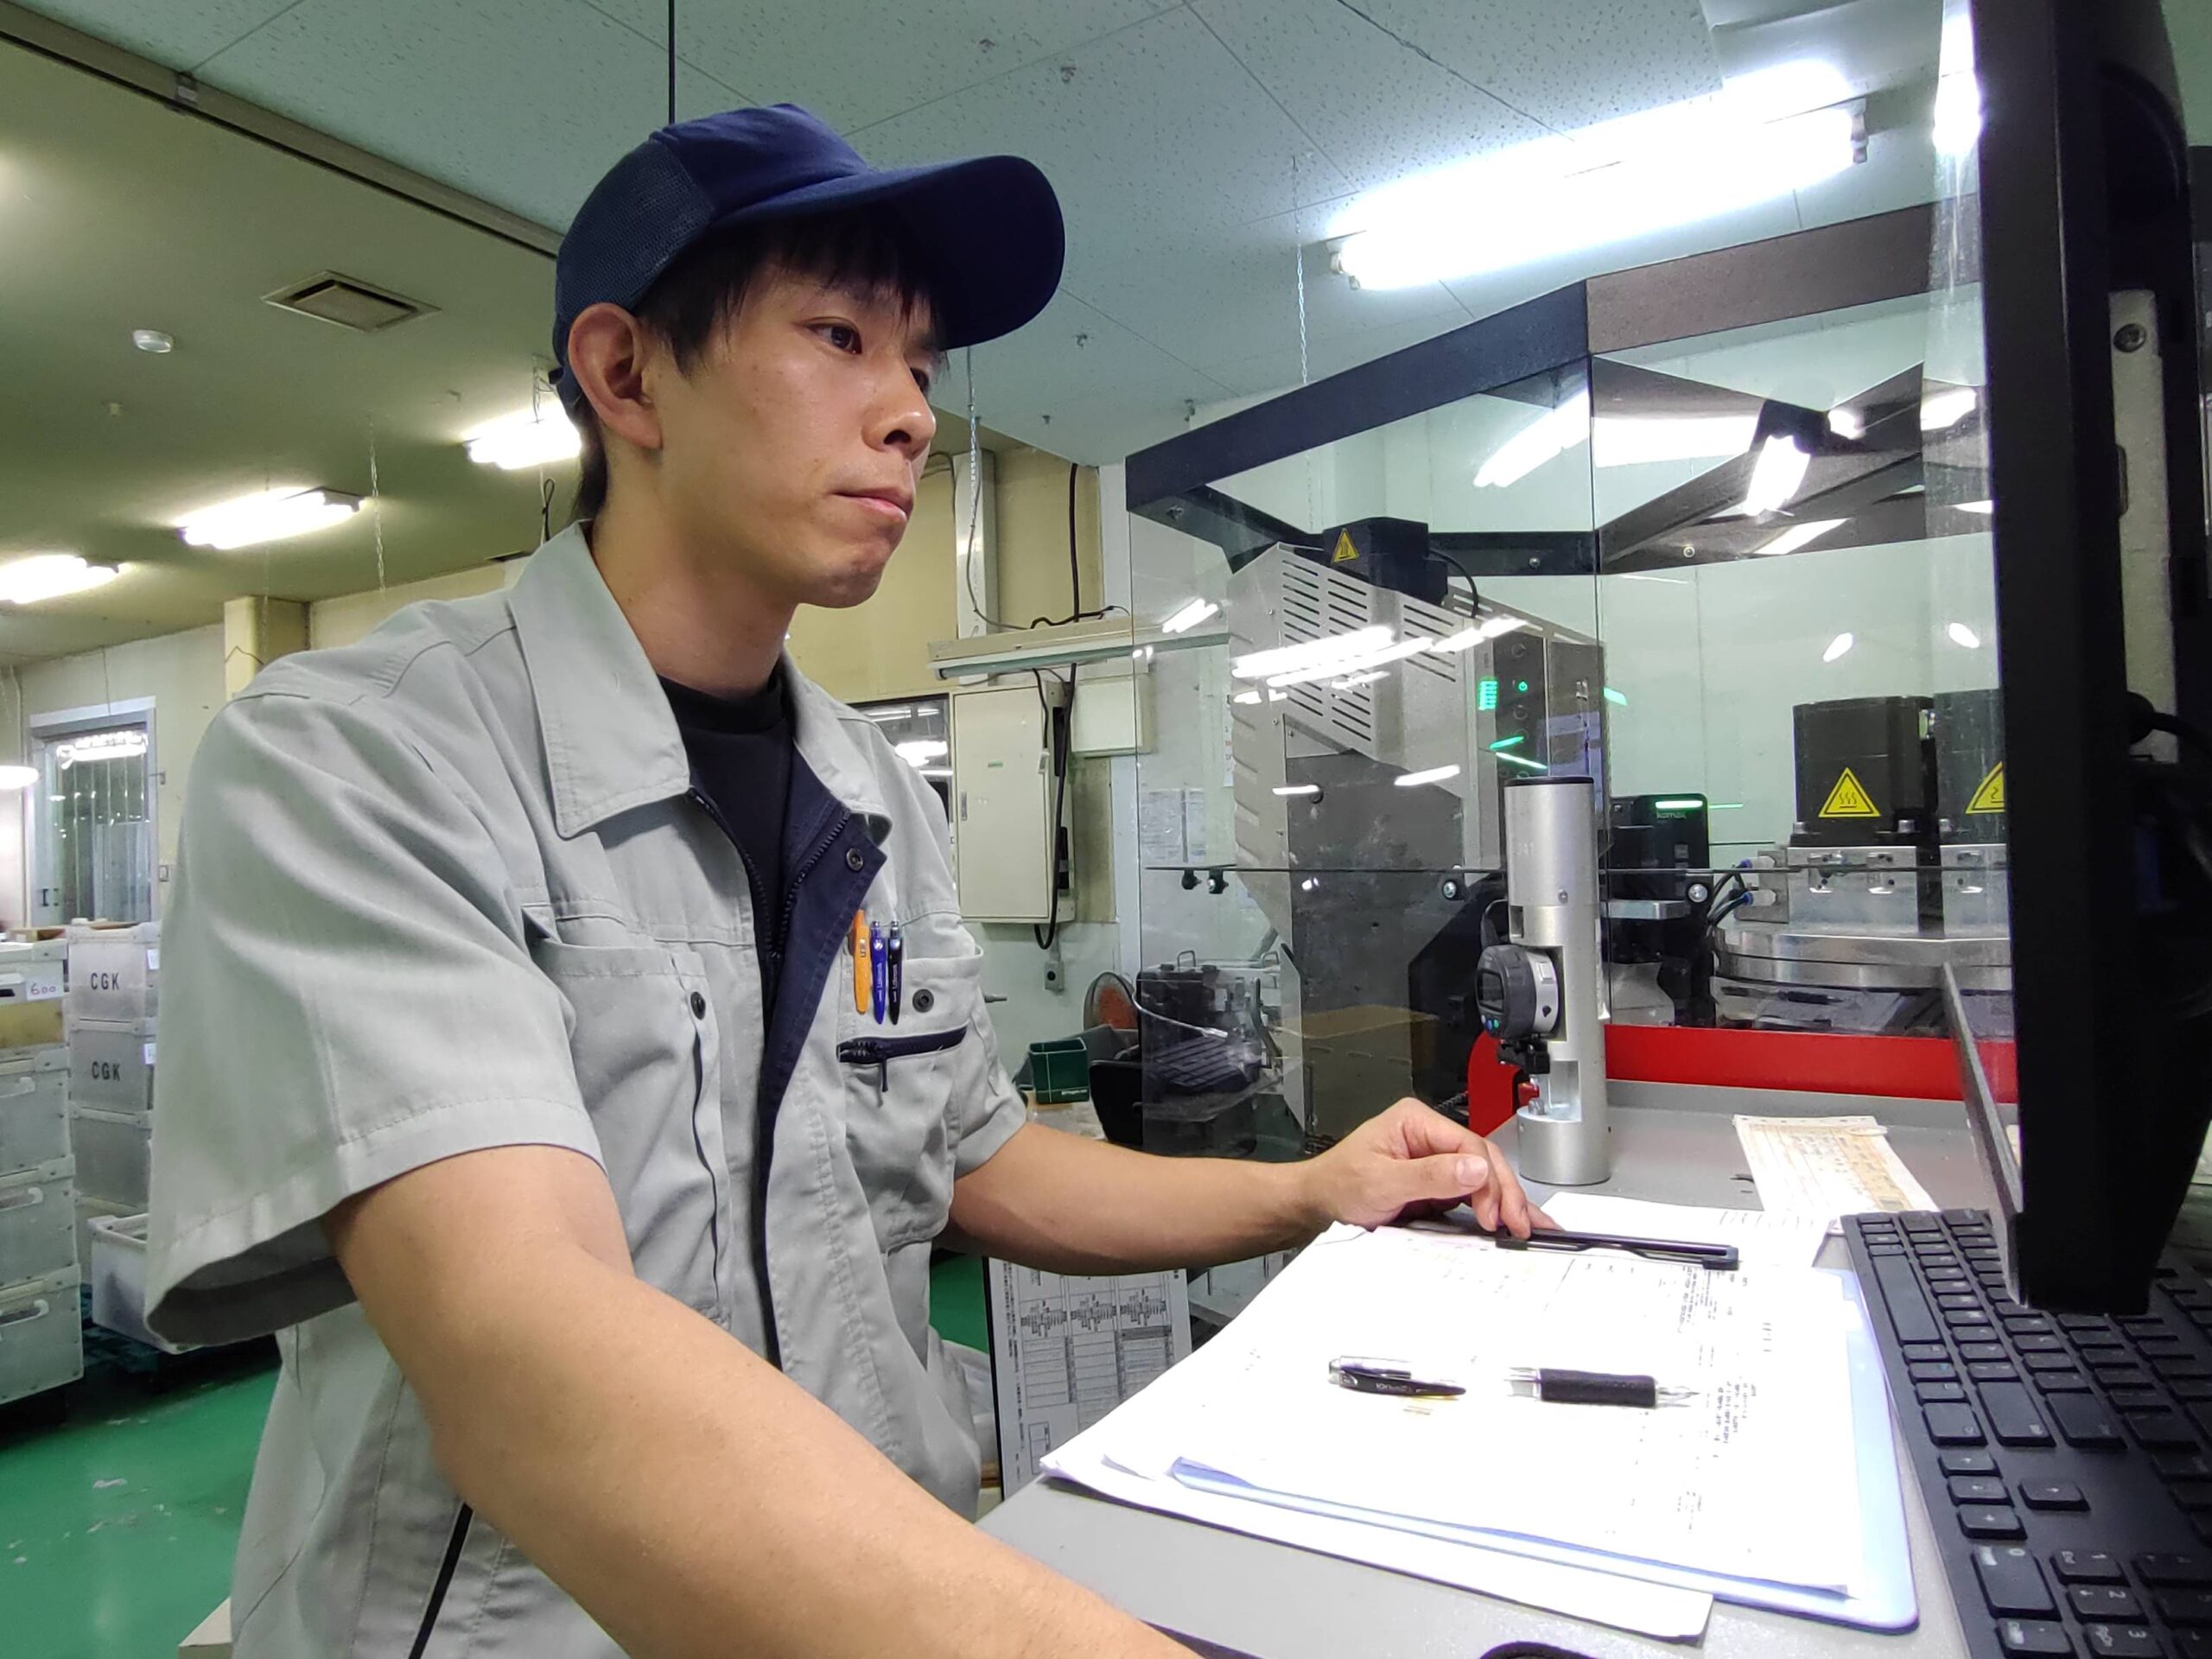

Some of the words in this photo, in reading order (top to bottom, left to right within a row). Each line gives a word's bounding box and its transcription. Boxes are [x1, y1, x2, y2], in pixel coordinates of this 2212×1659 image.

[91, 972, 120, 990] CGK
[30, 983, 56, 995] 600
[92, 1061, 121, 1080] CGK
[2108, 1590, 2126, 1599] 2
[2127, 1629, 2147, 1639] 3
